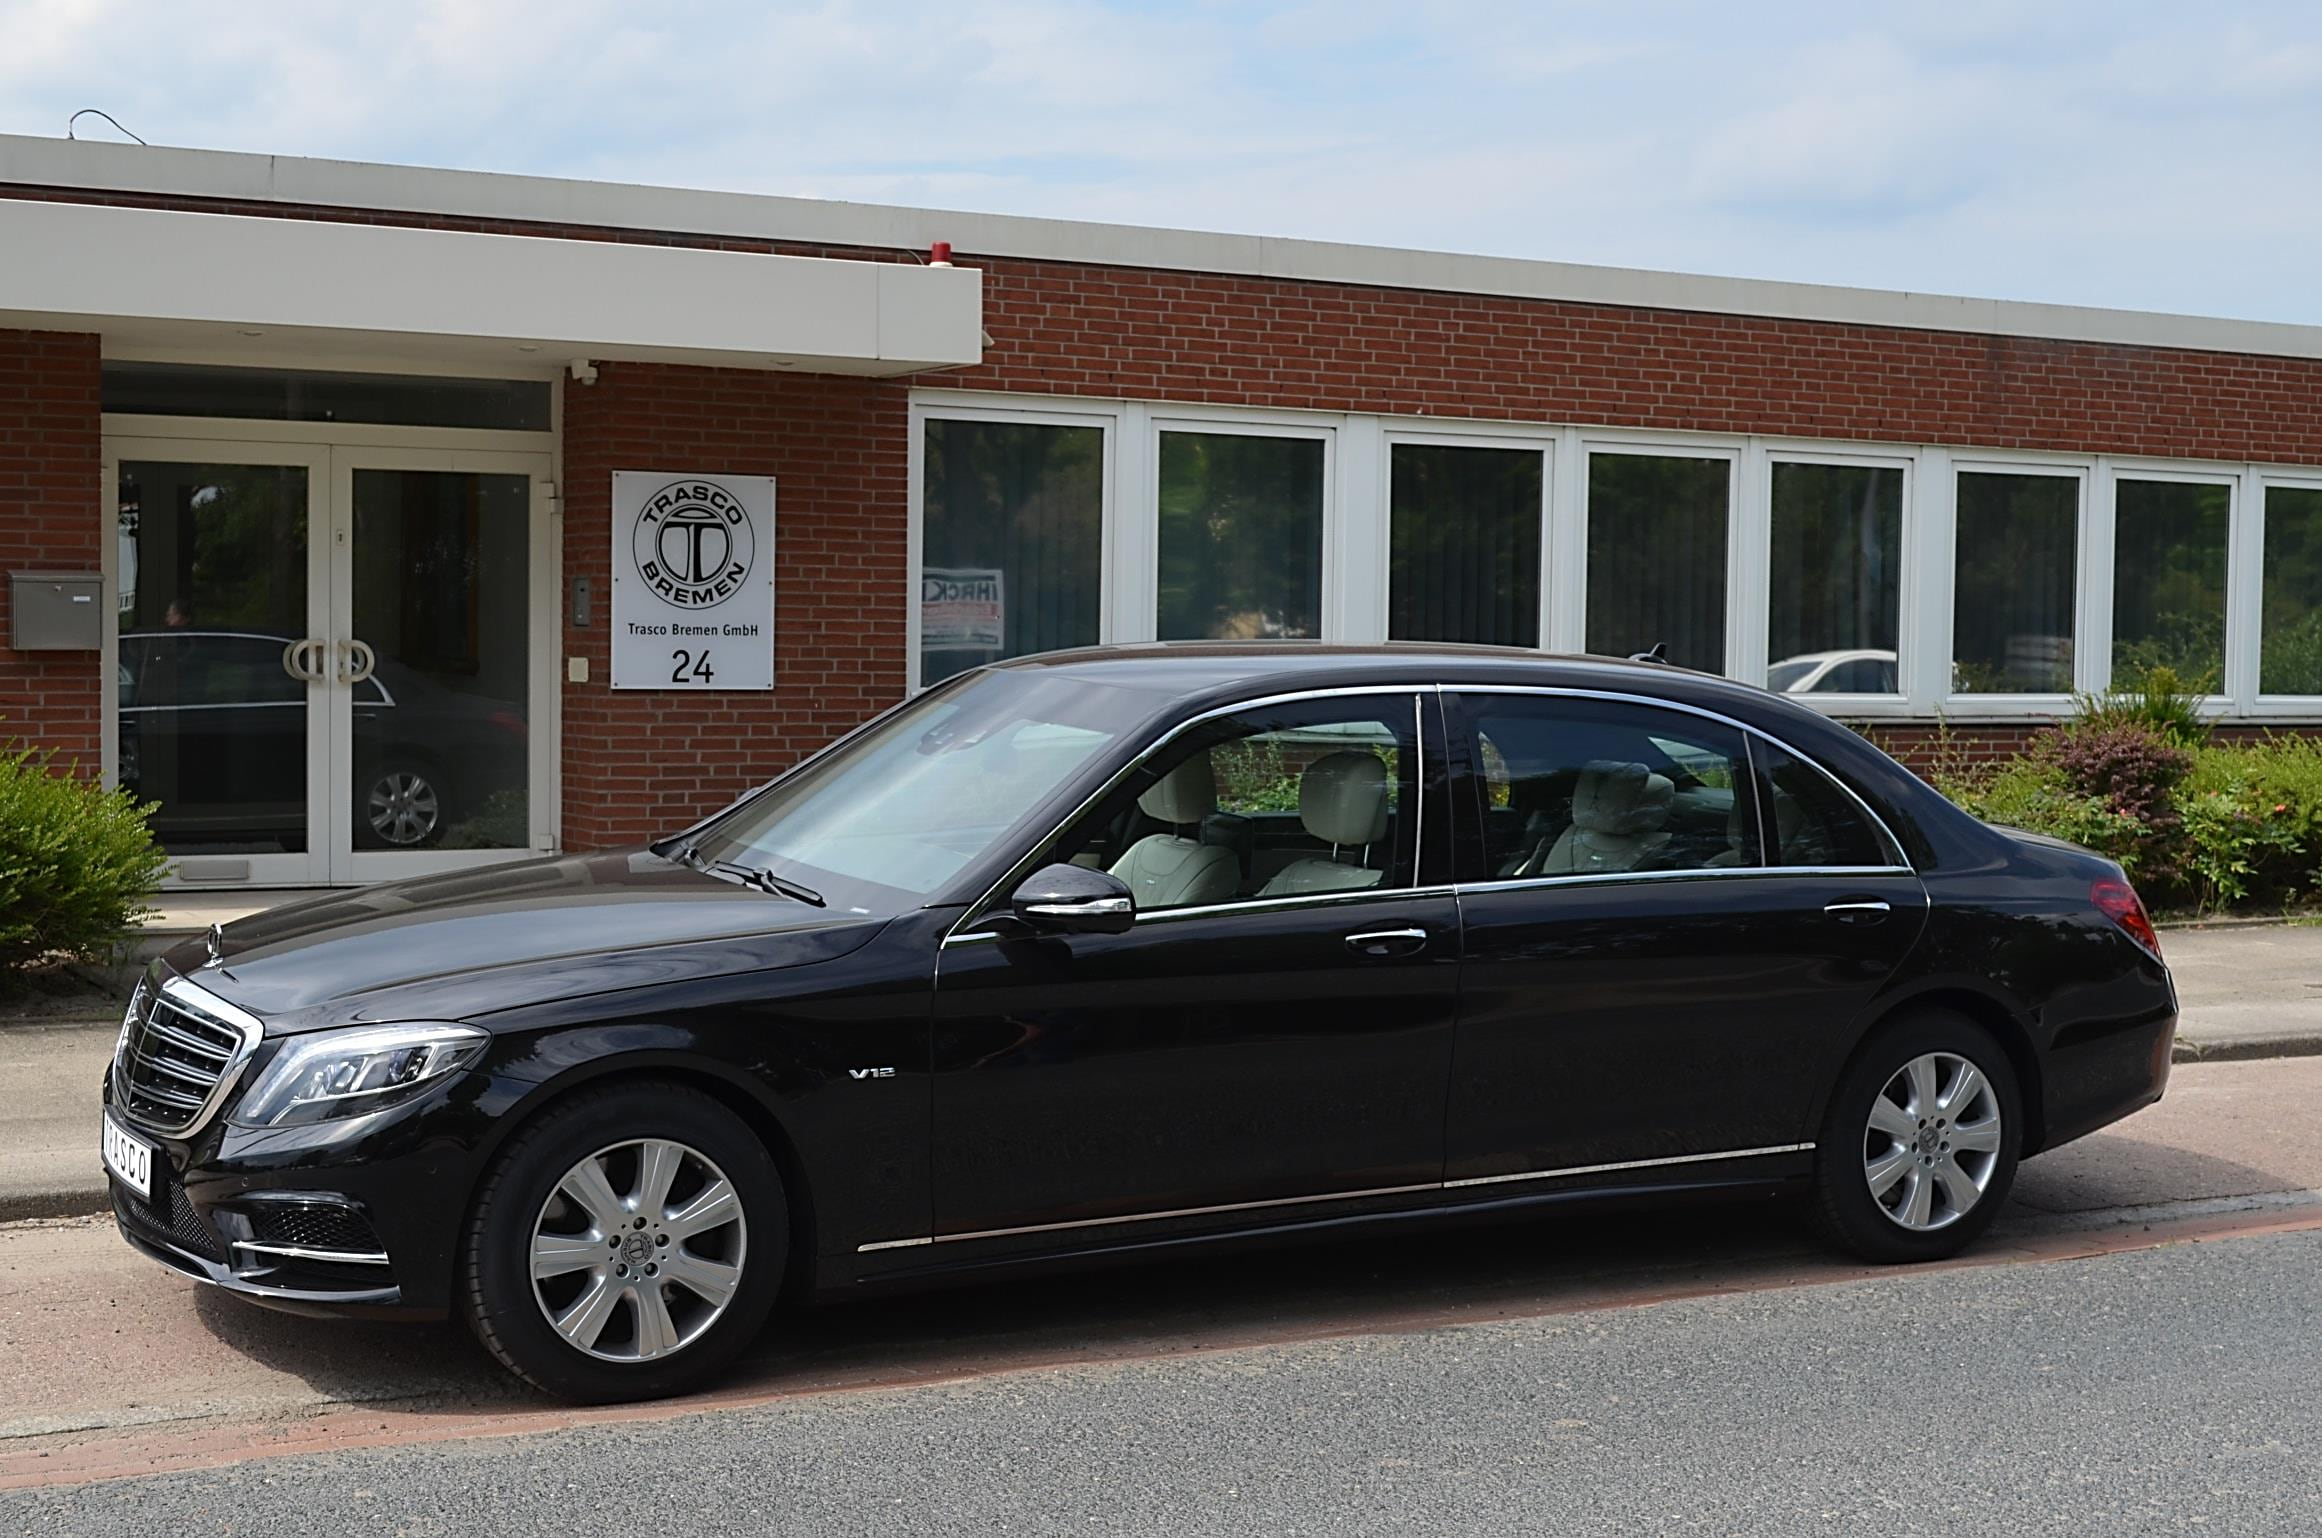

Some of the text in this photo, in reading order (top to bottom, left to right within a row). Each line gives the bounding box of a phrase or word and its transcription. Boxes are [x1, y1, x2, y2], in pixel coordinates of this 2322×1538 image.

[642, 485, 743, 525] TRASCO
[642, 560, 745, 605] BREMEN
[628, 622, 758, 637] Trasco Bremen GmbH
[671, 649, 714, 684] 24
[848, 1066, 896, 1080] V12
[105, 1117, 147, 1185] TRASCO
